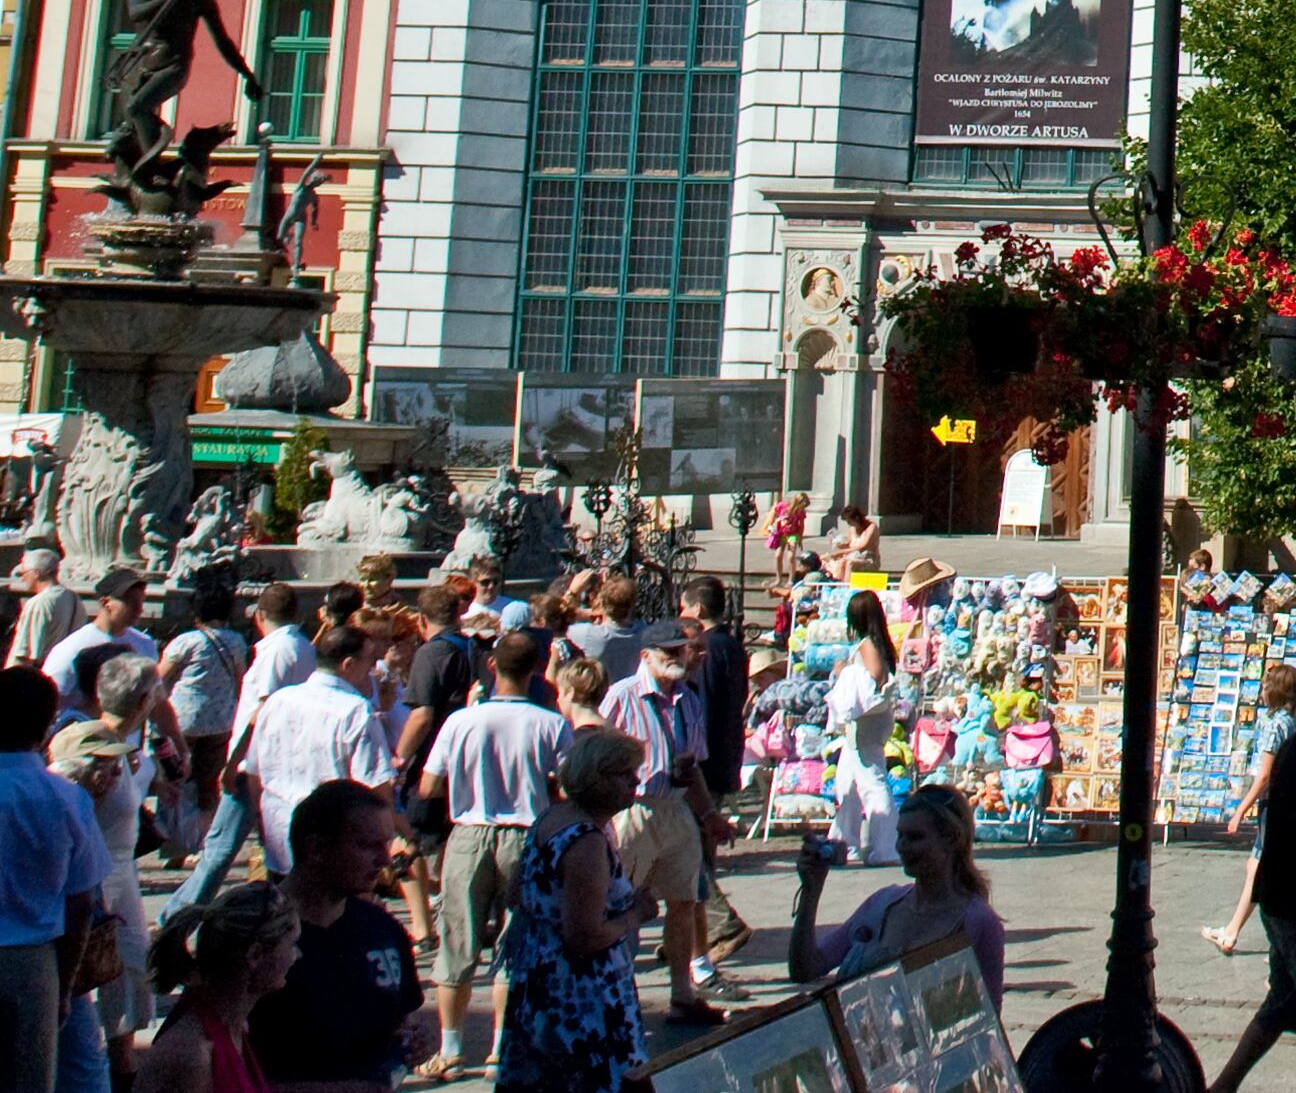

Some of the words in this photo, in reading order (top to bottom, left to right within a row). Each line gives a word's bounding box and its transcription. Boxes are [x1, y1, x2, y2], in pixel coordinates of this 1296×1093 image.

[934, 73, 982, 83] OCALONY
[983, 74, 991, 83] Z
[992, 73, 1033, 84] POŻARU
[1050, 75, 1111, 85] KATARZYNY
[1030, 100, 1043, 108] DO
[949, 124, 963, 137] W
[966, 124, 1029, 137] DWORZE
[1031, 125, 1089, 139] ARTUSA
